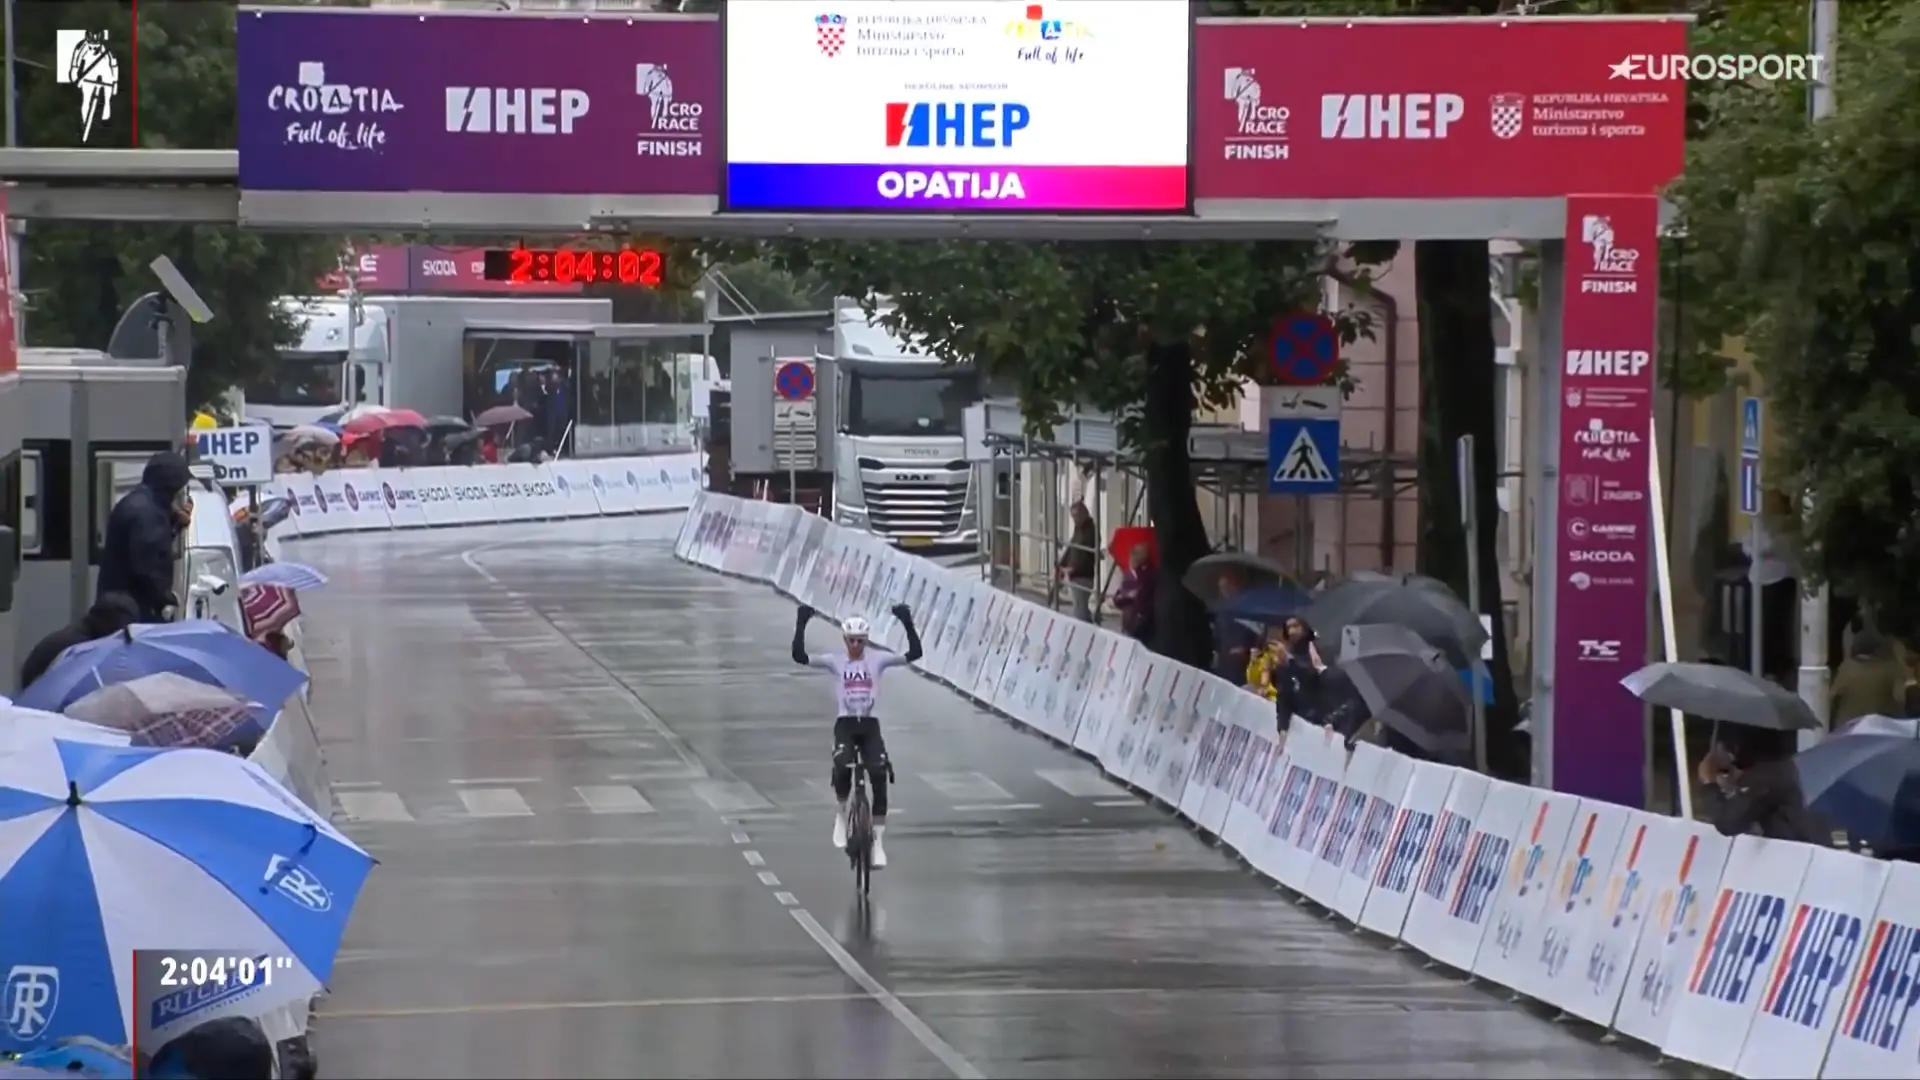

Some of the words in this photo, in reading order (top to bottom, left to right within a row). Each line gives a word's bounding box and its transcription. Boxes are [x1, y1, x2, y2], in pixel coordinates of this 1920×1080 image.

[1018, 46, 1041, 61] Full
[1045, 46, 1058, 64] of
[268, 84, 405, 114] CROATIA
[496, 88, 590, 134] HEP
[669, 103, 703, 117] CRO
[1257, 106, 1290, 120] CRO
[1370, 93, 1465, 139] HEP
[1533, 107, 1625, 120] Ministarstvo
[658, 117, 699, 131] RACE
[936, 102, 1030, 147] HEP
[1246, 121, 1286, 134] RACE
[1533, 124, 1588, 136] turizma
[1600, 124, 1646, 138] sporta
[286, 120, 324, 143] Full
[328, 121, 347, 148] of
[357, 122, 386, 149] life
[637, 140, 702, 156] FINISH
[1225, 144, 1289, 159] FINISH
[876, 171, 1025, 200] OPATIJA
[1610, 248, 1640, 260] CRO
[510, 250, 661, 283] 2:04:02
[1581, 280, 1638, 293] FINISH
[1594, 350, 1650, 376] HEP
[212, 432, 260, 455] HEP
[894, 473, 936, 481] DAF
[1710, 890, 1786, 1004] HEP
[1784, 908, 1862, 1030] HEP
